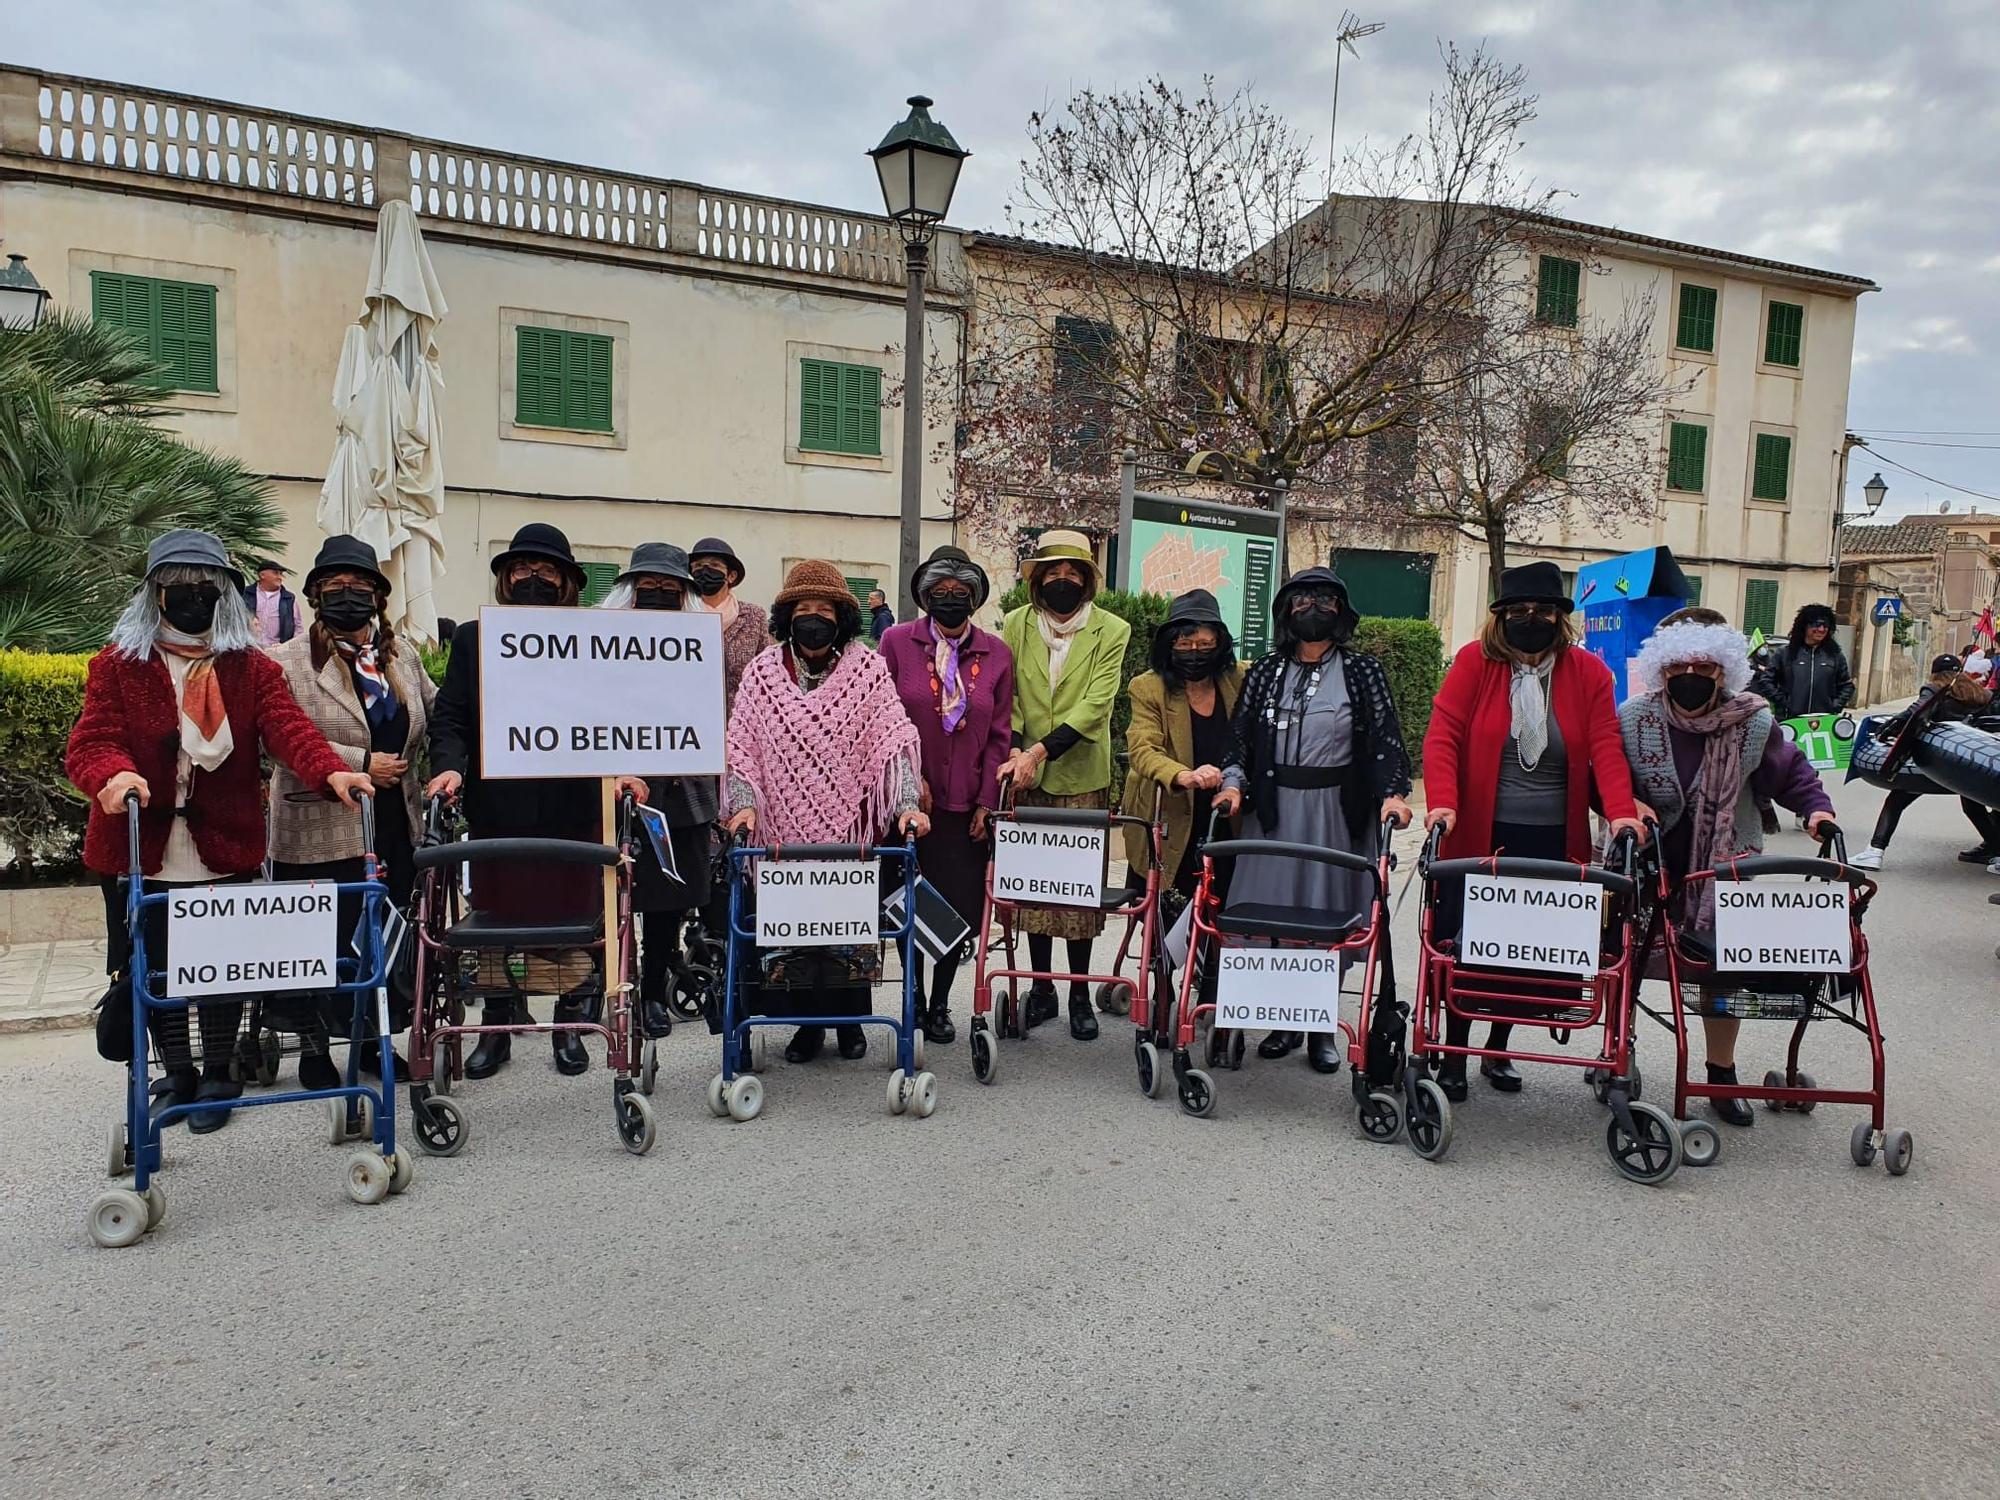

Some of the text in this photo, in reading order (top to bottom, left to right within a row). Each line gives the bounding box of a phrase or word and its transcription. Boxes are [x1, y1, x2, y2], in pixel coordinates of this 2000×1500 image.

[501, 633, 702, 662] SOM MAJOR
[508, 725, 700, 751] NO BENEITA
[1799, 731, 1833, 760] 17
[998, 829, 1101, 850] SOM MAJOR
[760, 870, 875, 885] SOM MAJOR
[999, 877, 1095, 898] NO BENEITA
[173, 895, 333, 918] SOM MAJOR
[1468, 885, 1599, 911] SOM MAJOR
[1719, 893, 1844, 909] SOM MAJOR
[763, 921, 872, 937] NO BENEITA
[1469, 940, 1590, 966] NO BENEITA
[1723, 947, 1842, 964] NO BENEITA
[178, 959, 328, 985] NO BENEITA
[1222, 955, 1334, 973] SOM MAJOR
[1222, 1006, 1331, 1023] NO BENEITA
